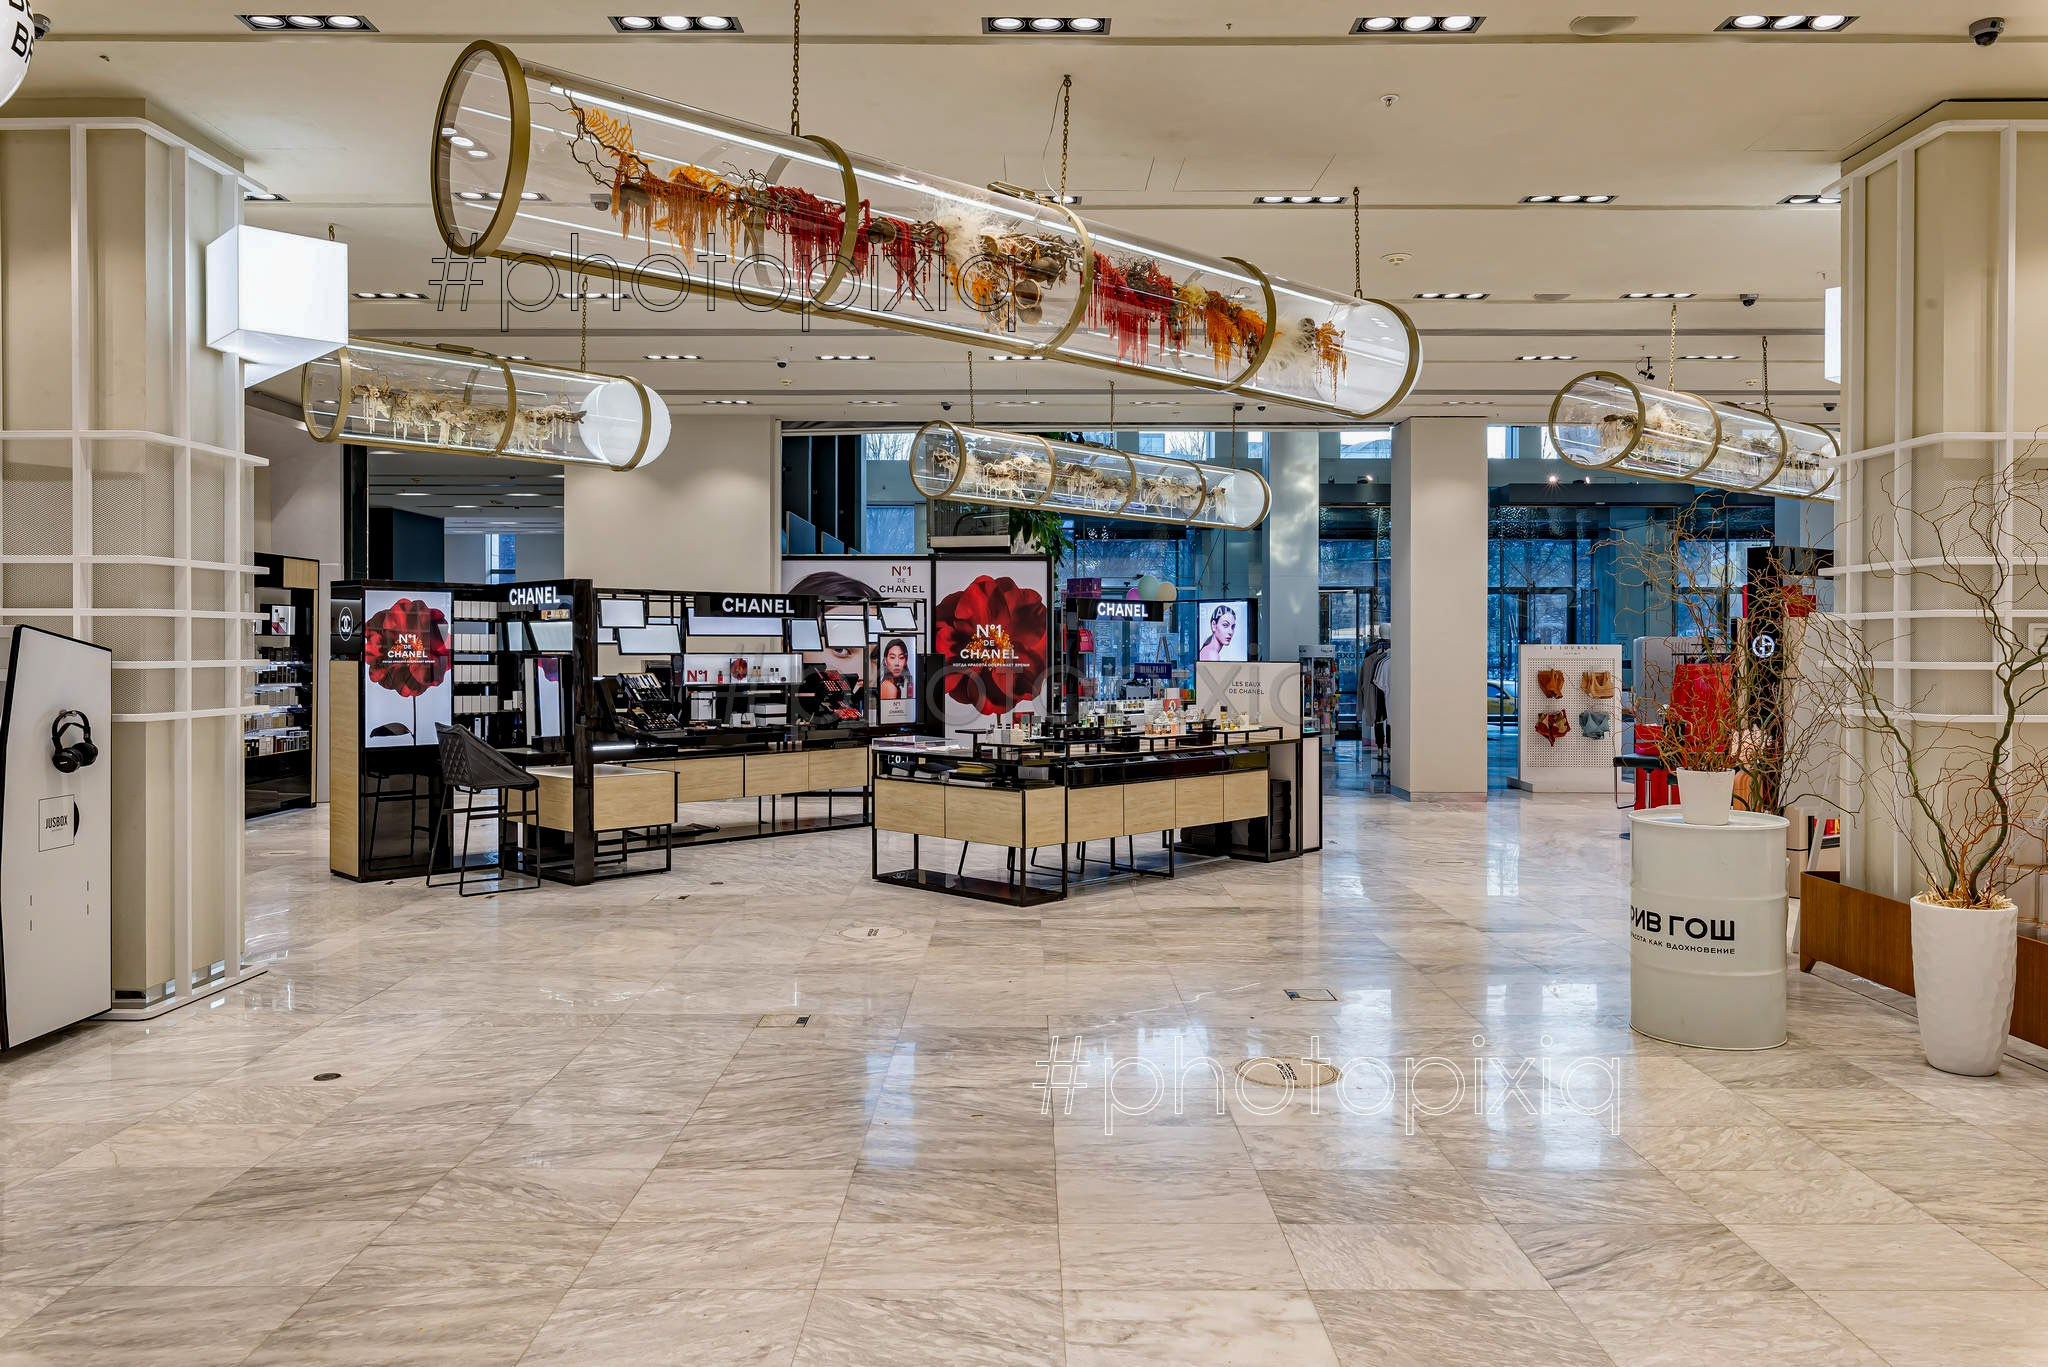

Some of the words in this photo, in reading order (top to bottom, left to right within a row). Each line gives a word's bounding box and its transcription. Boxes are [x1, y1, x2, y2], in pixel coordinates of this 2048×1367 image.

[509, 586, 560, 606] CHANEL
[879, 585, 925, 593] CHANEL
[722, 597, 795, 614] CHANEL
[1097, 602, 1149, 617] CHANEL
[387, 650, 428, 658] CHANEL
[960, 649, 1019, 659] CHANEL
[45, 815, 69, 830] JUSBOX
[1669, 915, 1735, 941] ГОШ
[1648, 938, 1663, 947] КАК
[1666, 942, 1736, 955] ВДОХНОВЕНИЕ
